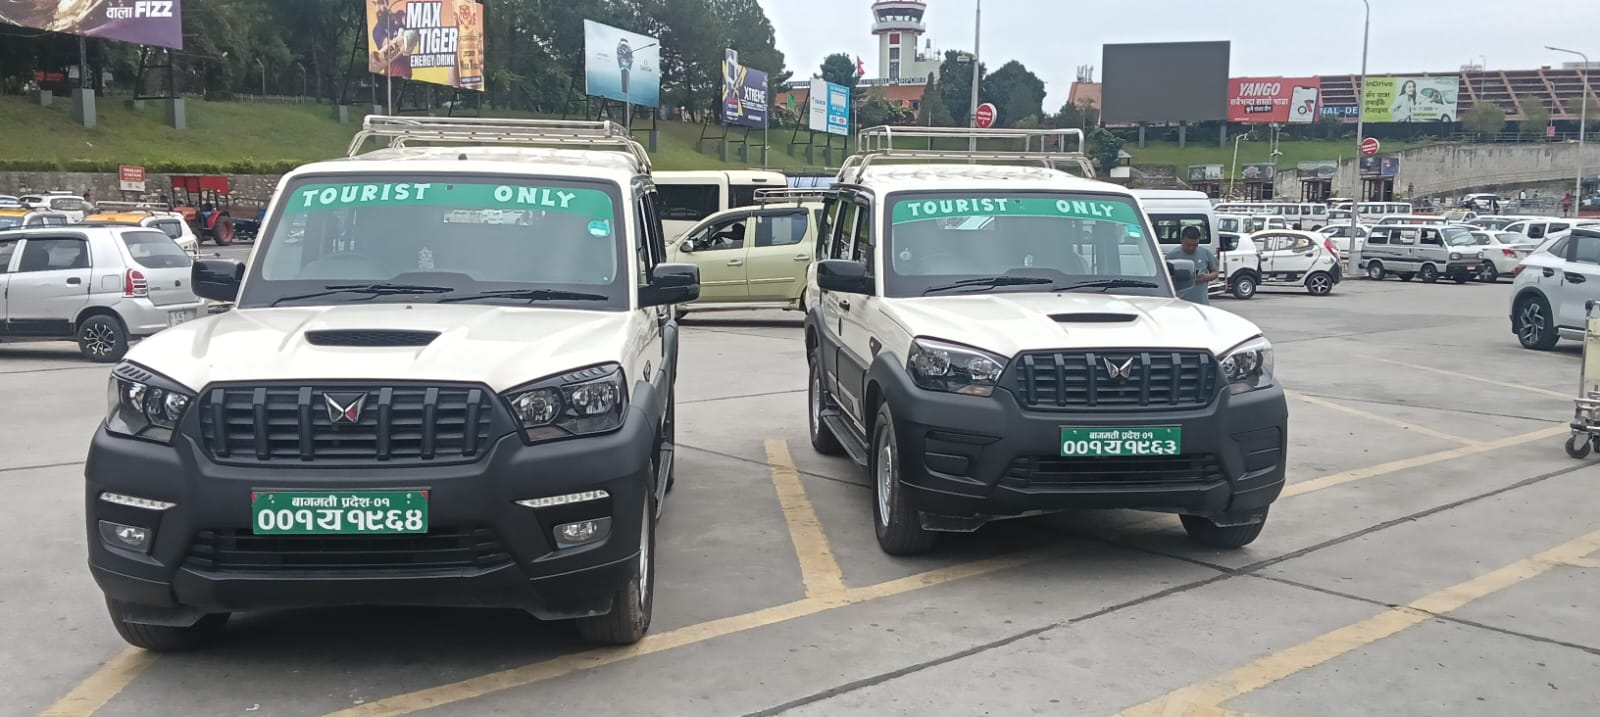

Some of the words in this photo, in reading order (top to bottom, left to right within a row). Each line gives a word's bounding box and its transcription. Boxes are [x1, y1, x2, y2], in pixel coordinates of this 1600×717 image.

[134, 1, 173, 18] FIZZ
[406, 2, 442, 28] MAX
[419, 28, 459, 54] TIGER
[410, 54, 435, 67] ENERGY
[436, 54, 456, 66] DRINK
[744, 85, 766, 104] XTREME
[1239, 82, 1281, 97] YANGO
[1320, 107, 1339, 115] NAL
[1345, 106, 1358, 114] DE
[302, 183, 431, 207] TOURIST
[494, 185, 576, 208] ONLY
[908, 198, 1008, 216] TOURIST
[1056, 200, 1114, 217] ONLY
[291, 494, 337, 508] बागमती
[257, 509, 313, 531] ००१
[347, 509, 424, 532] १९६४
